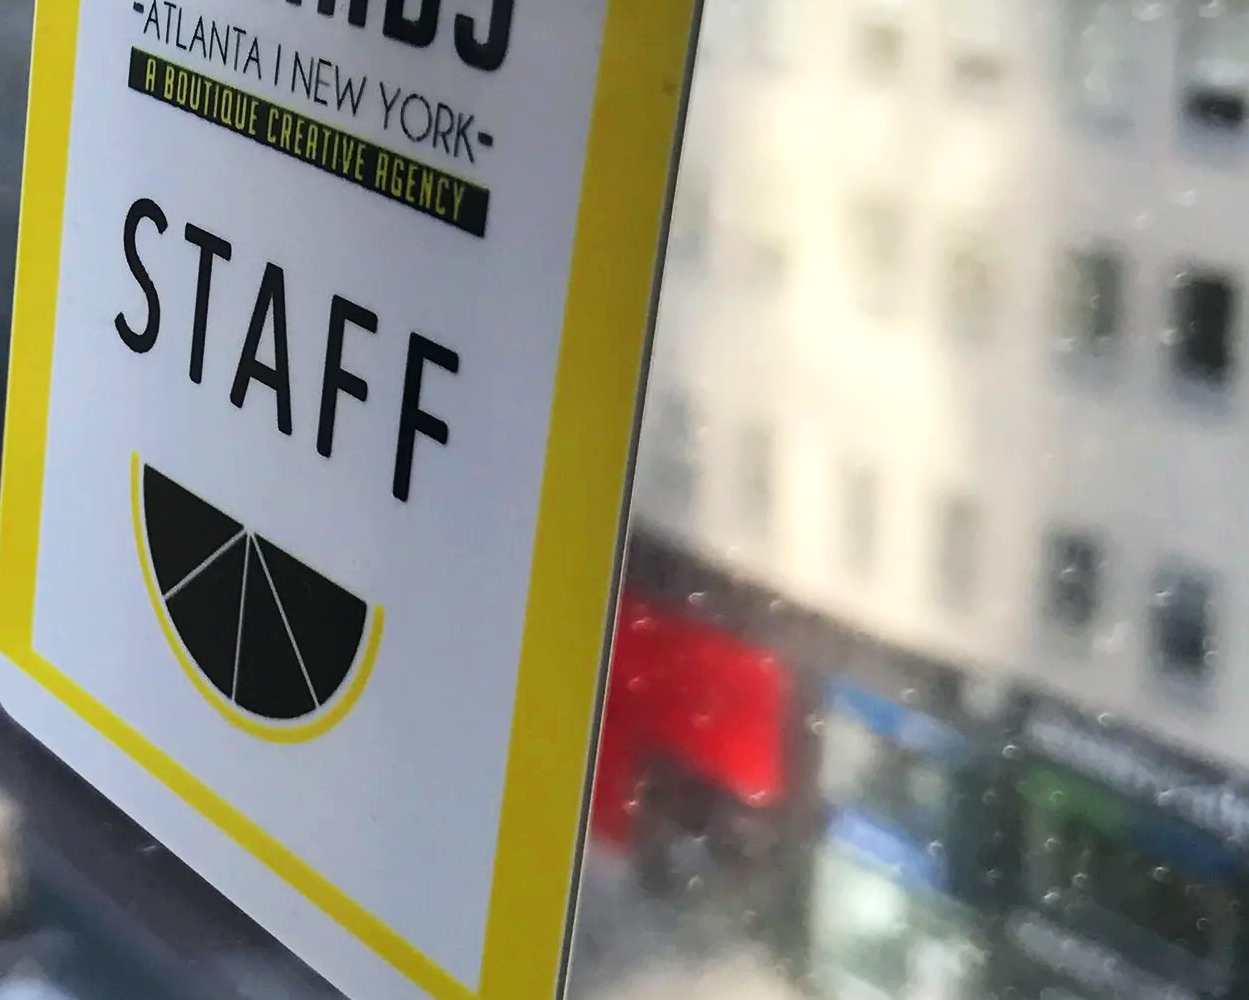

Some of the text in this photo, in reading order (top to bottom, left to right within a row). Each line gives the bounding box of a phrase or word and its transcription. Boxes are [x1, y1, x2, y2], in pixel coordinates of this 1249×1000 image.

[145, 58, 466, 221] A BOUTIQUE CREATIVE AGENCY
[291, 50, 367, 117] NEW
[114, 197, 460, 503] STAFF
